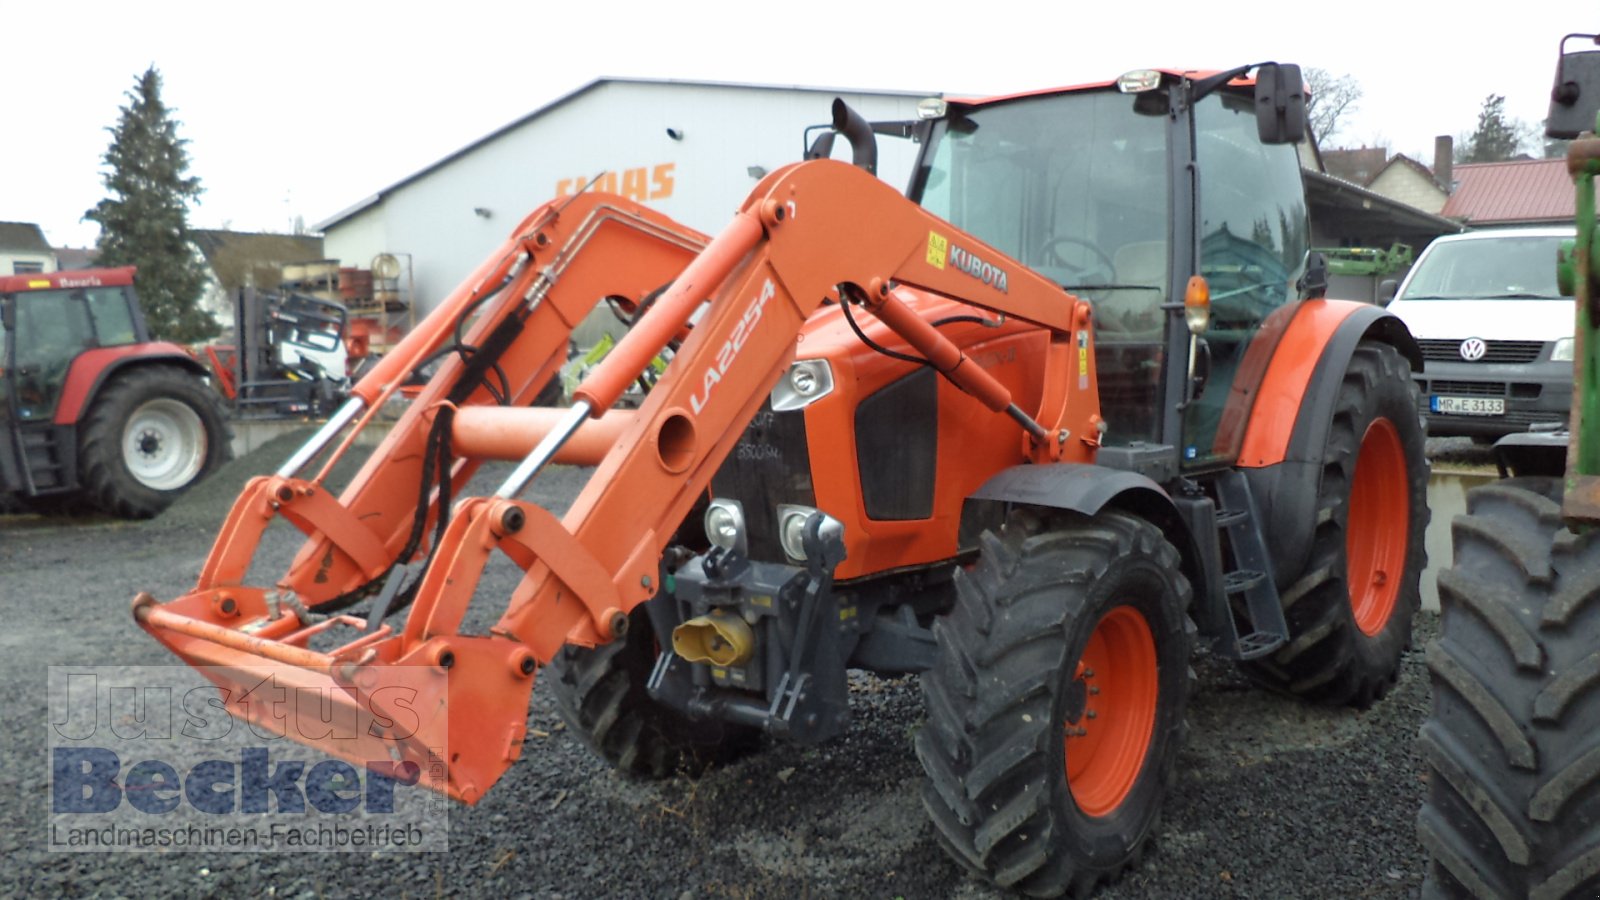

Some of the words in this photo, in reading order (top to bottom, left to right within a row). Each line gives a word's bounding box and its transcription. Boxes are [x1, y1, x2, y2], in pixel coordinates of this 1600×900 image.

[950, 243, 1008, 295] KUBOTA
[690, 278, 774, 415] LA2254
[1438, 399, 1454, 410] MR
[1461, 399, 1470, 411] E
[1472, 400, 1503, 412] 3133
